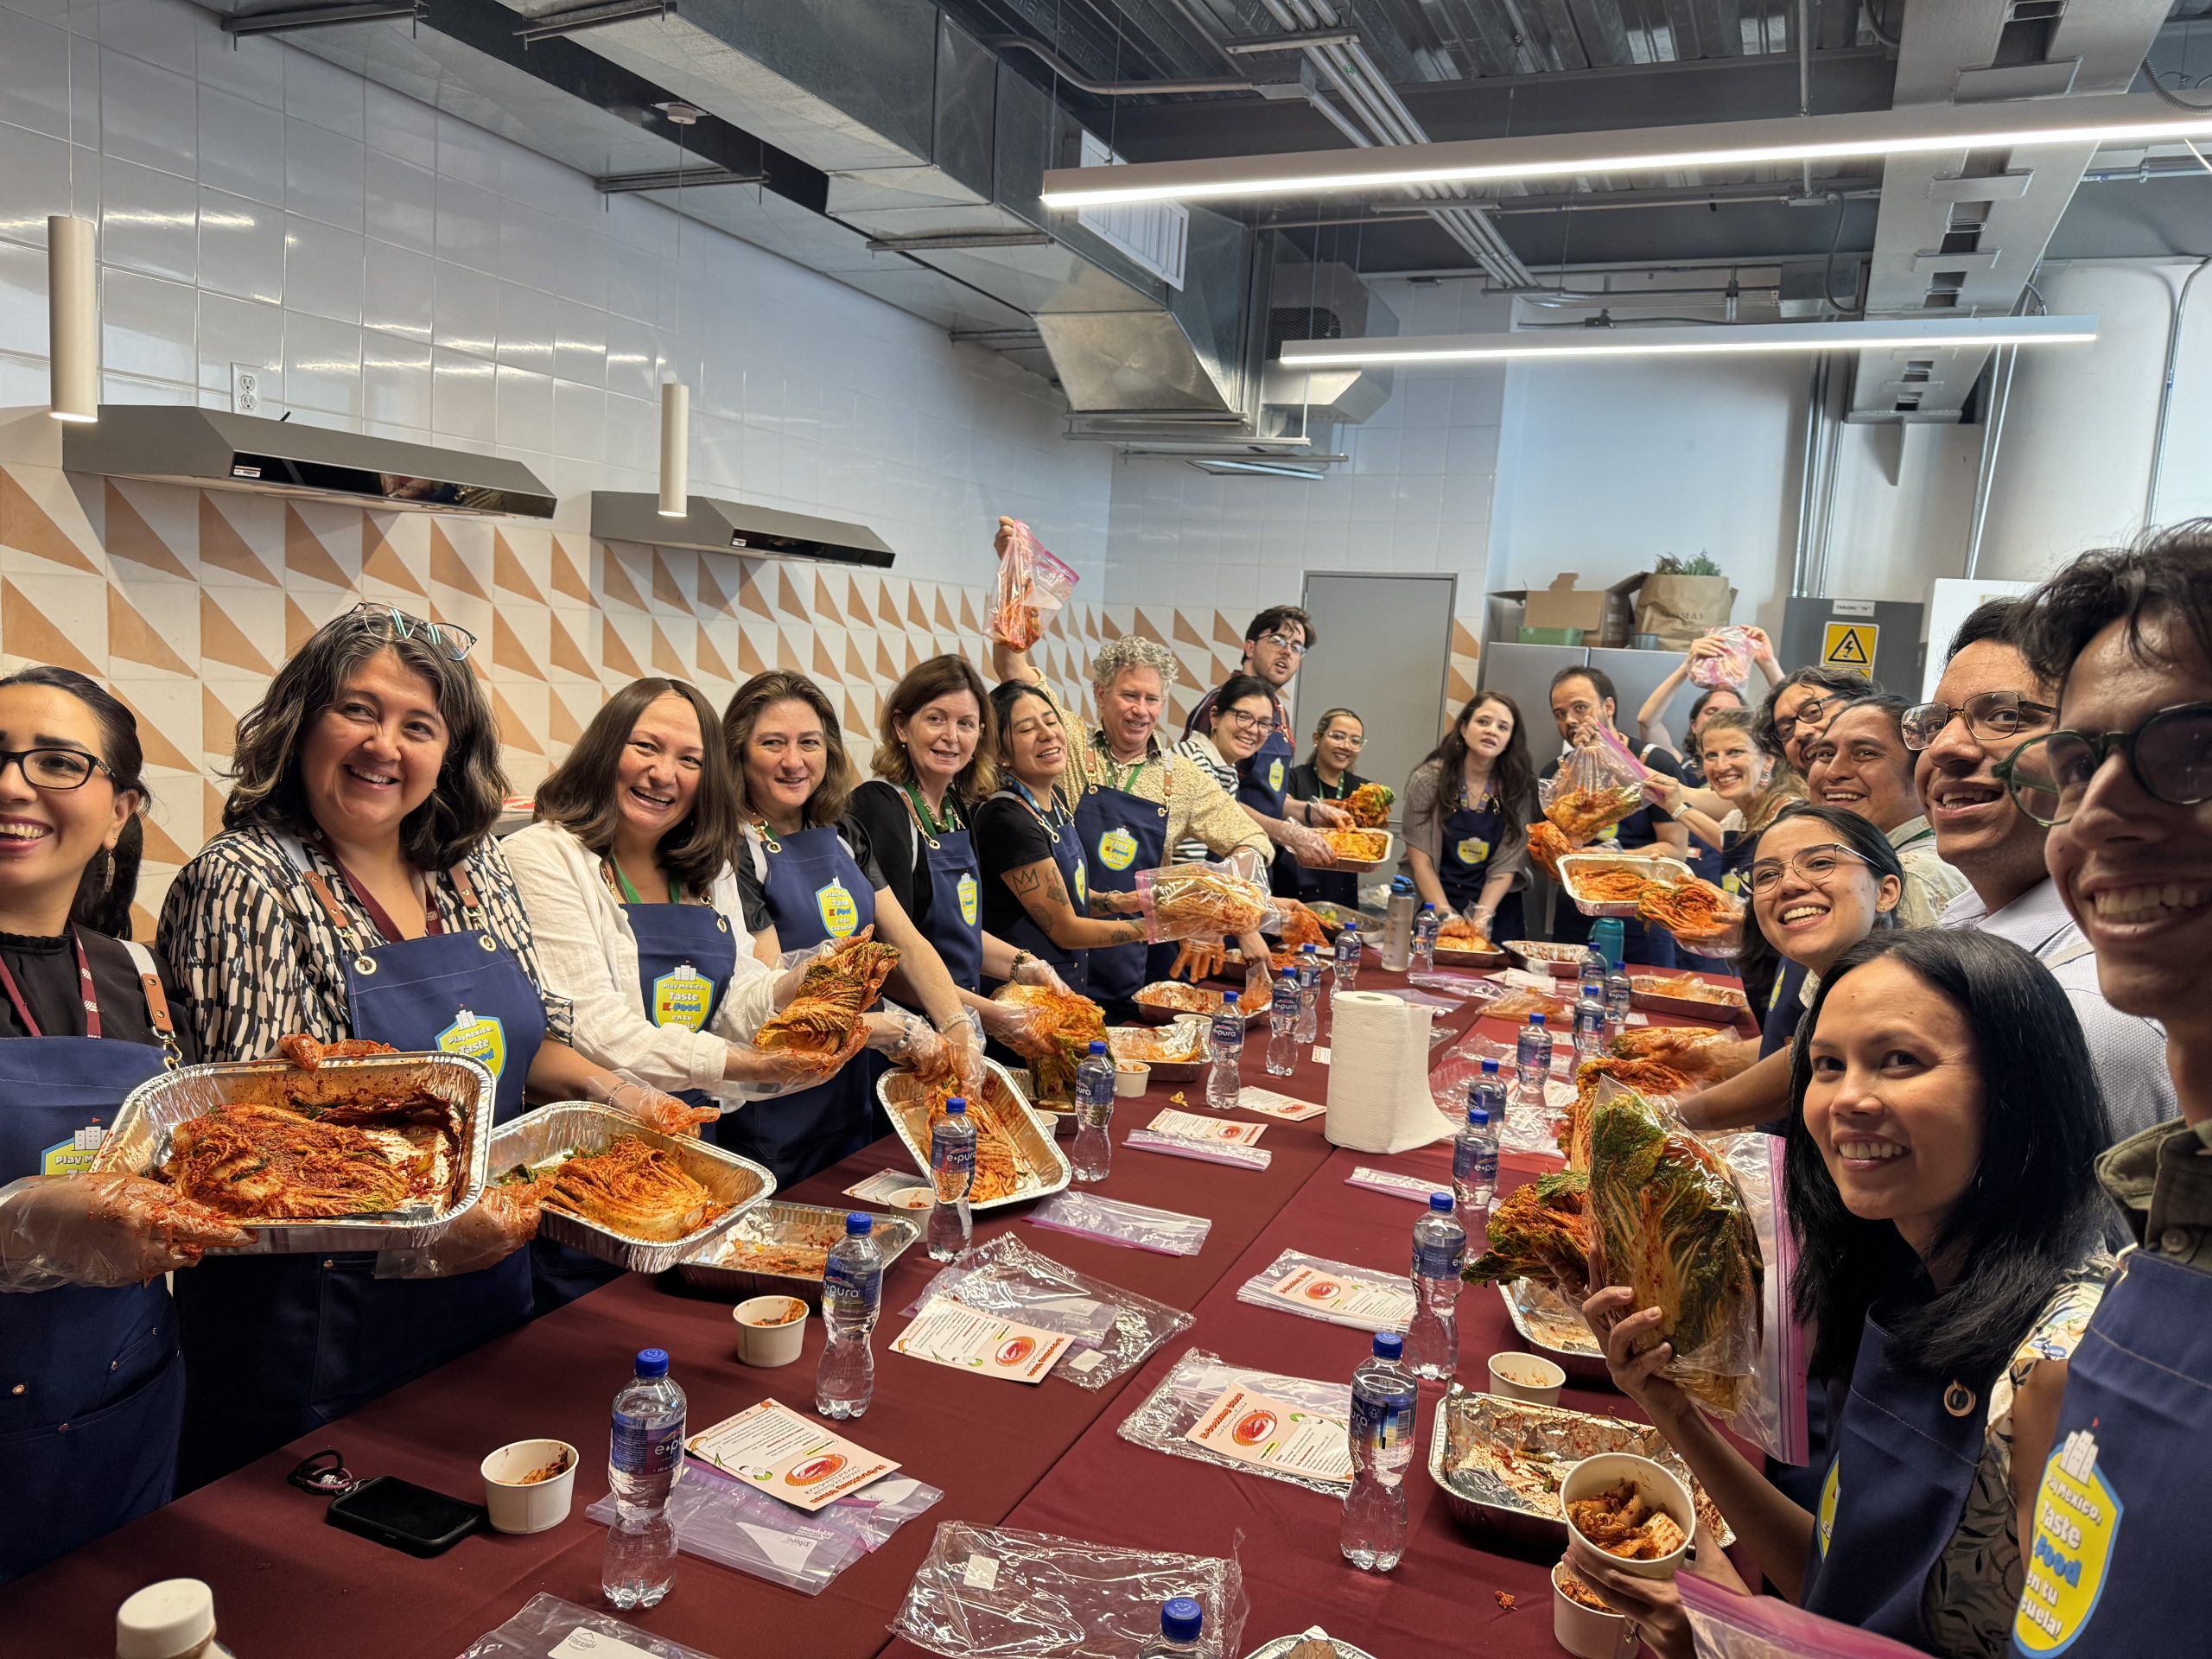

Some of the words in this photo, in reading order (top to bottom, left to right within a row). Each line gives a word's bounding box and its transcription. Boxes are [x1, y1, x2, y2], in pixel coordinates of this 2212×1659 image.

[663, 1002, 701, 1011] K-Food
[669, 992, 698, 1001] Taste
[448, 1034, 467, 1044] Play
[459, 1039, 489, 1054] Taste
[55, 1155, 82, 1165] Play
[2056, 1481, 2102, 1527] Mexico,
[2040, 1499, 2082, 1549] Taste
[2034, 1534, 2082, 1589] Food
[2042, 1578, 2059, 1606] tu
[2020, 1596, 2063, 1641] cuela!
